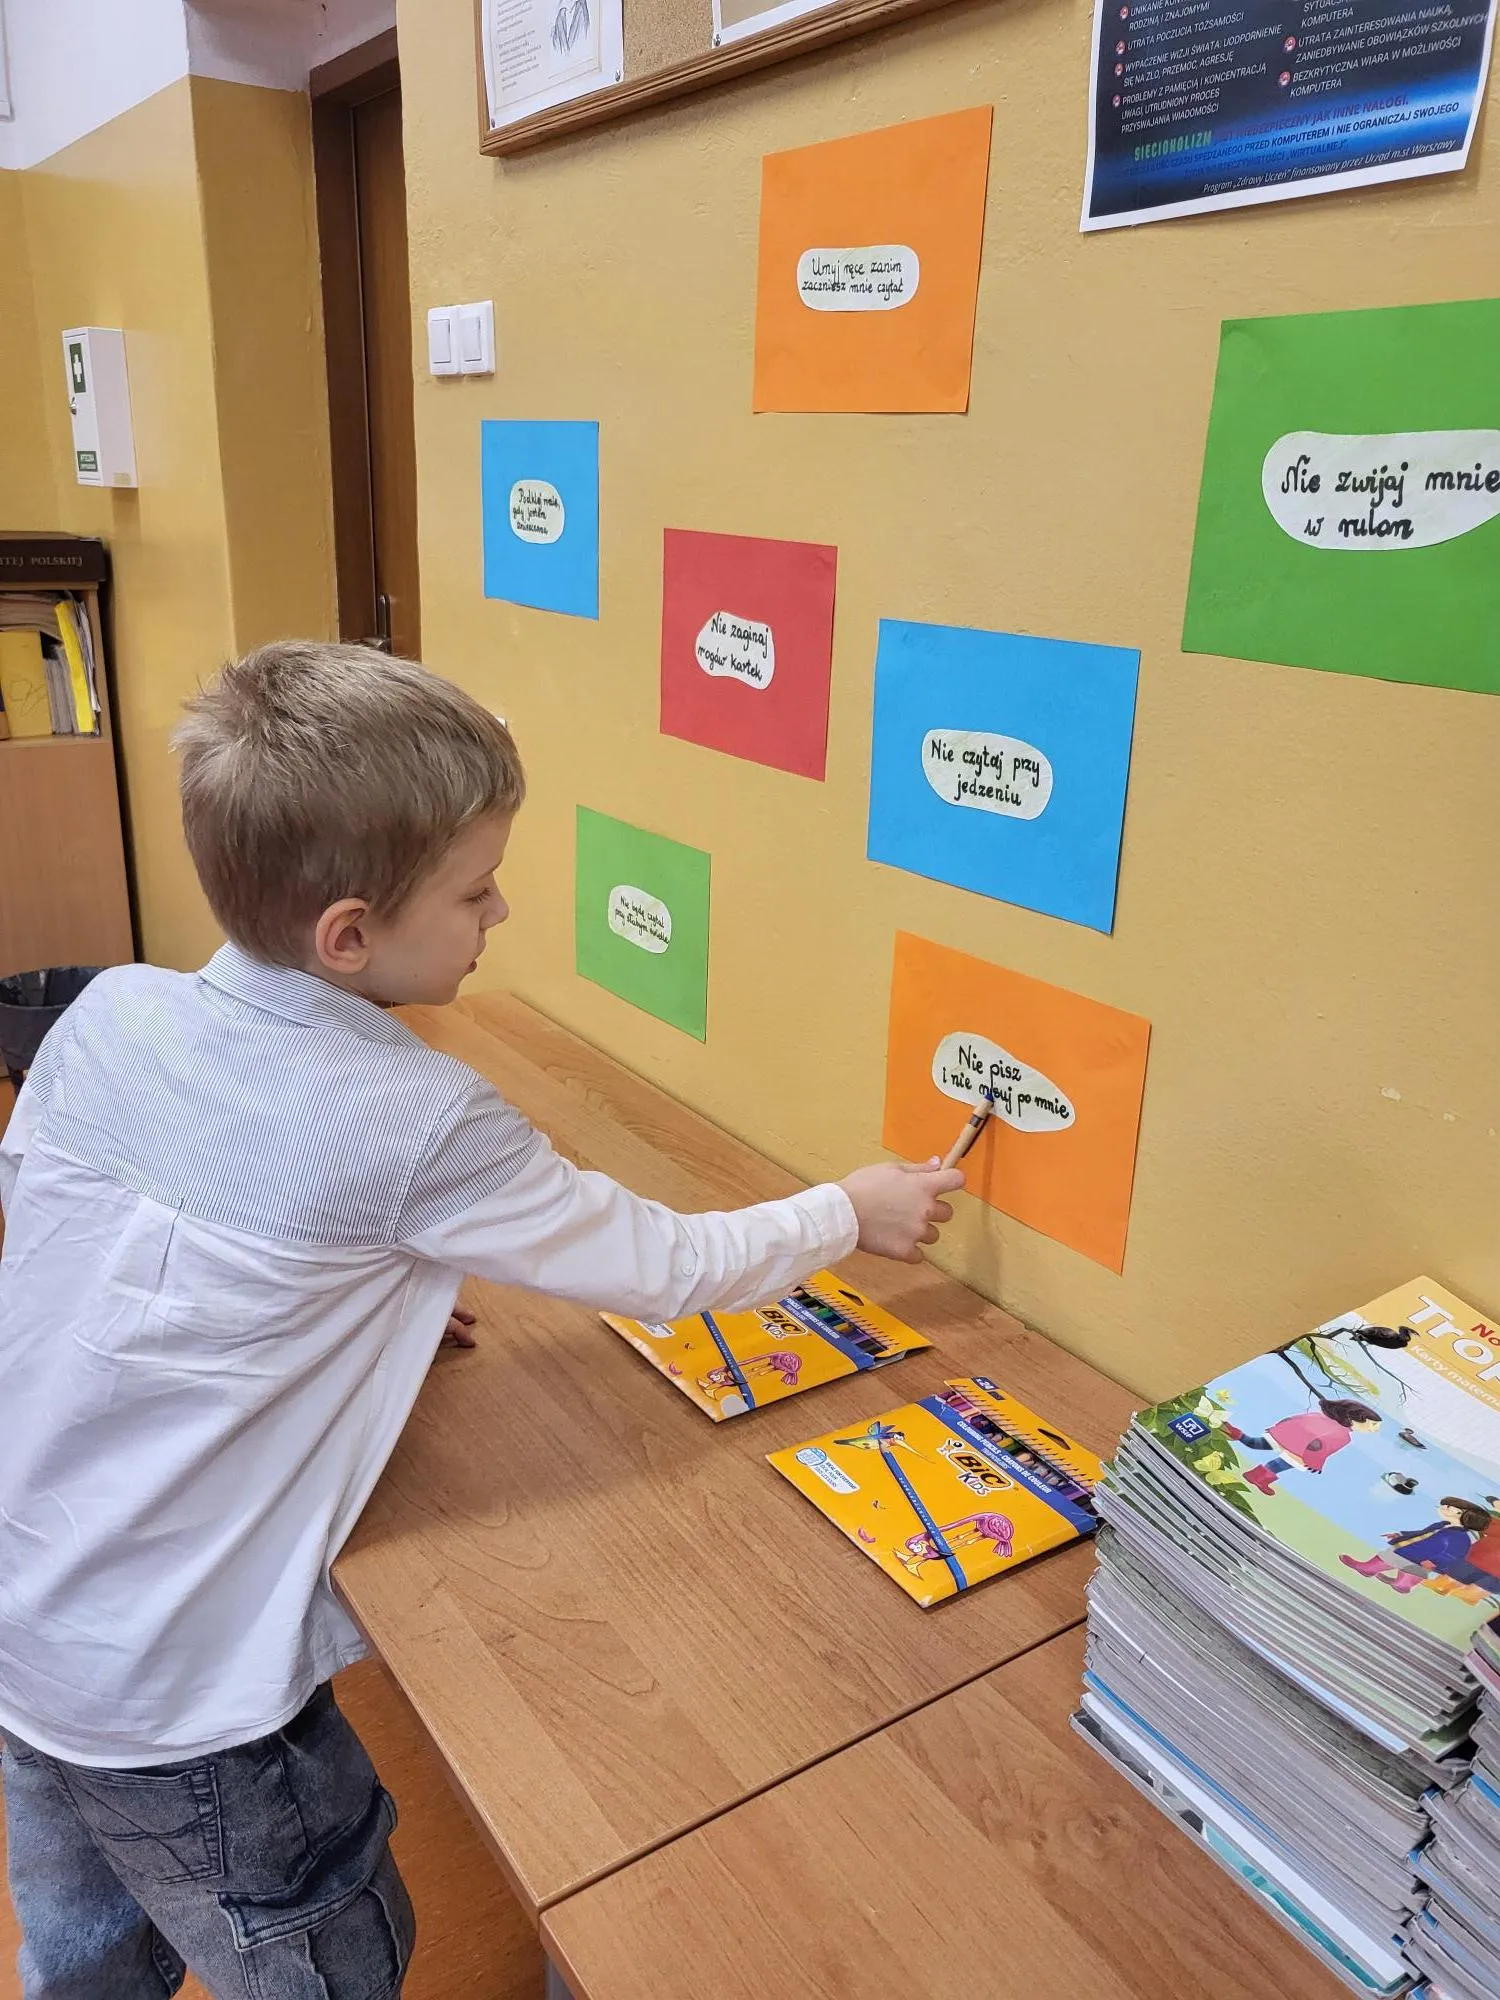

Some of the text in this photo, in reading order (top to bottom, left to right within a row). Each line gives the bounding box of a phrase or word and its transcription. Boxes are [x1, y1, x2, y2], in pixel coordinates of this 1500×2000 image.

[1129, 14, 1160, 32] RODZINĄ
[1165, 1, 1211, 22] ZNAJOMYMI
[1130, 0, 1163, 17] UNIKANIE
[1301, 7, 1354, 28] KOMPUTERA
[1127, 34, 1155, 50] UTRATA
[1156, 25, 1192, 43] POCZUCIA
[1296, 12, 1490, 63] ZANIEDBYWANIE OBOWIĄZKÓW SZKOLNYCH
[1298, 31, 1332, 48] UTRATA
[1332, 13, 1417, 40] ZAINTERESOWANIA
[1125, 53, 1169, 73] WYPACZENIE
[1170, 48, 1190, 62] WIZJI
[1223, 24, 1283, 48] UODPORNIENIE
[1292, 36, 1462, 83] BEZKRYTYCZNA WIARA W MOŻLIWOŚCI
[1122, 89, 1158, 105] PROBLEMY
[1145, 96, 1190, 114] UTRUDNIONY
[1190, 88, 1220, 103] PROCES
[1290, 79, 1342, 98] KOMPUTERA
[1121, 103, 1220, 134] PRZYSWAJANIA WIADOMOŚCI
[1244, 140, 1270, 153] PRZED
[1271, 127, 1331, 147] KOMPUTEREM
[1336, 123, 1351, 135] NIE
[1352, 110, 1412, 132] OGRANICZAJ
[1413, 102, 1460, 120] SWOJEGO
[1312, 110, 1332, 126] JAK
[1333, 104, 1361, 119] INNE
[1203, 180, 1233, 195] Program
[1290, 161, 1340, 182] finansowany
[1340, 156, 1364, 170] przez
[1411, 139, 1457, 156] Warszawy
[812, 256, 902, 283] Umyj ręce zanim
[801, 277, 904, 302] zaczniesz mnie czytać
[1280, 453, 1500, 509] Nie zwijaj mnie
[1303, 506, 1415, 541] w rulon
[30, 555, 84, 568] POLSKIEJ
[710, 611, 769, 660] Nie zaginaj
[697, 645, 763, 682] rogów kartek
[930, 738, 1041, 788] Nie czytaj przy
[953, 772, 1022, 807] jedzeniu
[957, 1044, 1023, 1093] Nie pisz
[950, 1071, 973, 1090] nie
[1017, 1092, 1032, 1119] po
[1034, 1094, 1070, 1120] mnie
[1410, 1344, 1449, 1372] Karty
[979, 1438, 1002, 1455] PENCILS
[1000, 1454, 1025, 1474] CRAYONS
[1027, 1473, 1053, 1495] COULEUR
